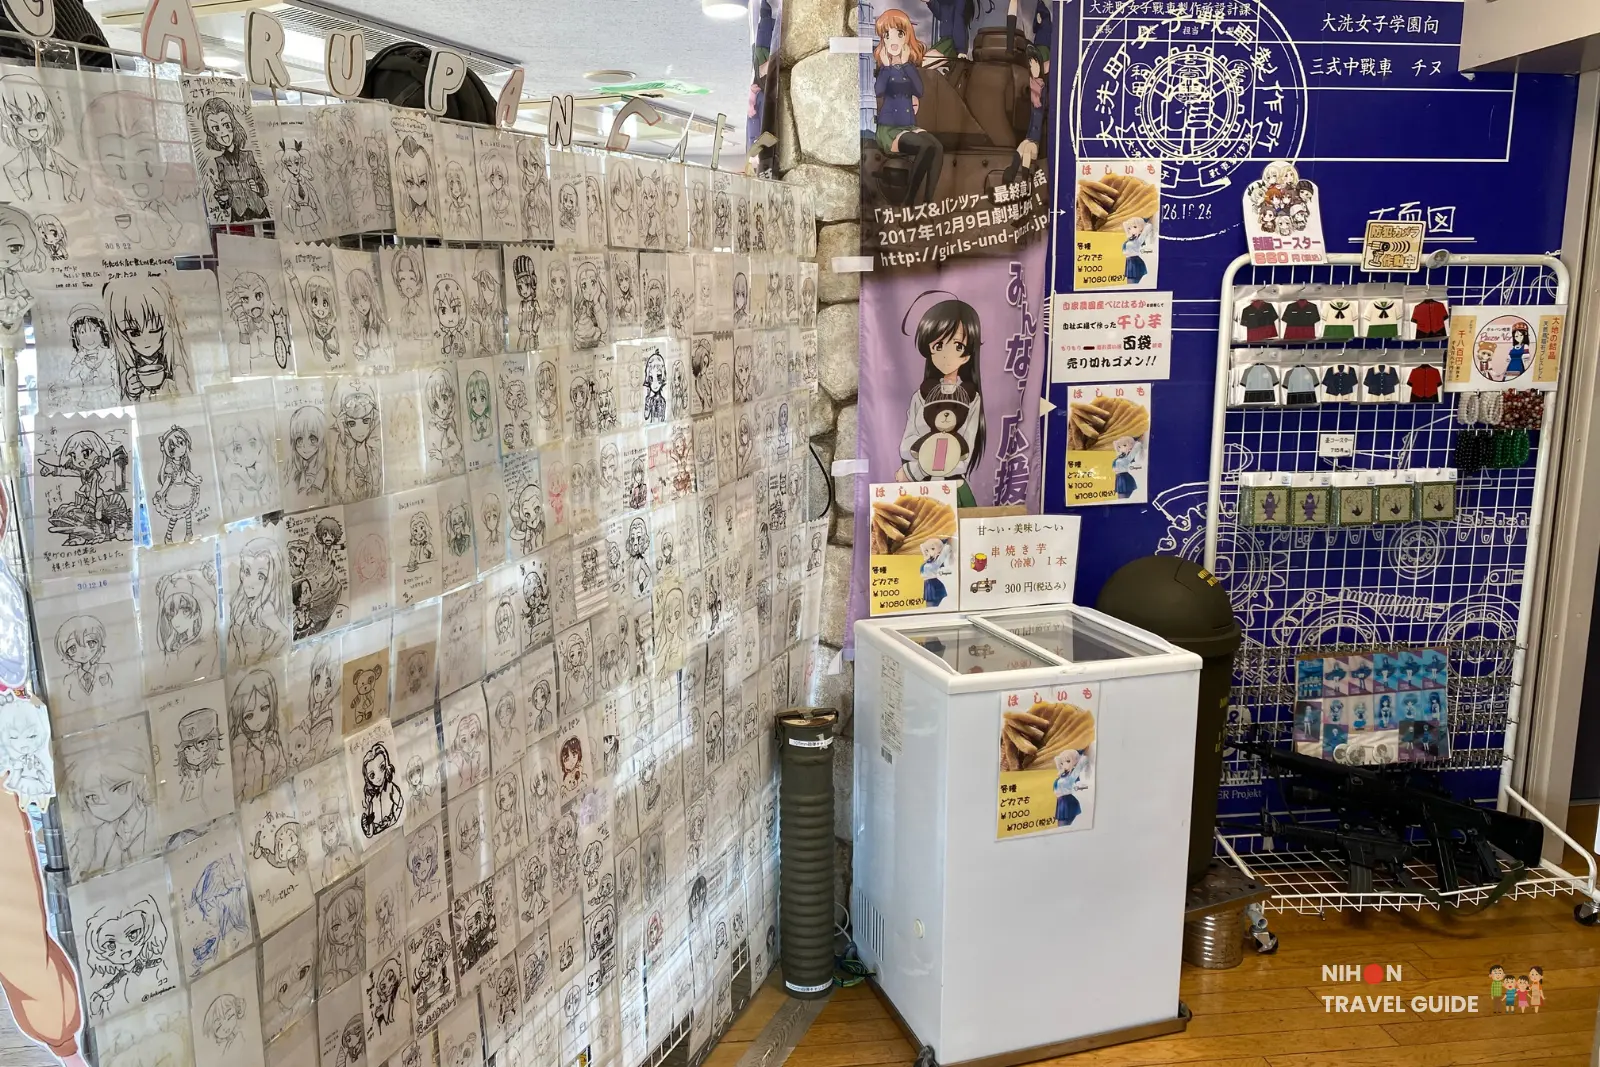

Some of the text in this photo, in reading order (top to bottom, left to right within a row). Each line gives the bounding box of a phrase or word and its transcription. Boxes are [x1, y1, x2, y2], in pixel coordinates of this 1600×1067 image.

[1321, 12, 1439, 35] 大洗女子学園向
[1411, 58, 1442, 77] チヌ
[1081, 163, 1156, 175] ほしいも
[1369, 224, 1421, 239] 防犯カメラ
[1381, 254, 1416, 268] 作動中
[1073, 387, 1145, 398] ほしいも
[875, 485, 951, 497] ほしいも
[1007, 687, 1093, 708] ほしいも
